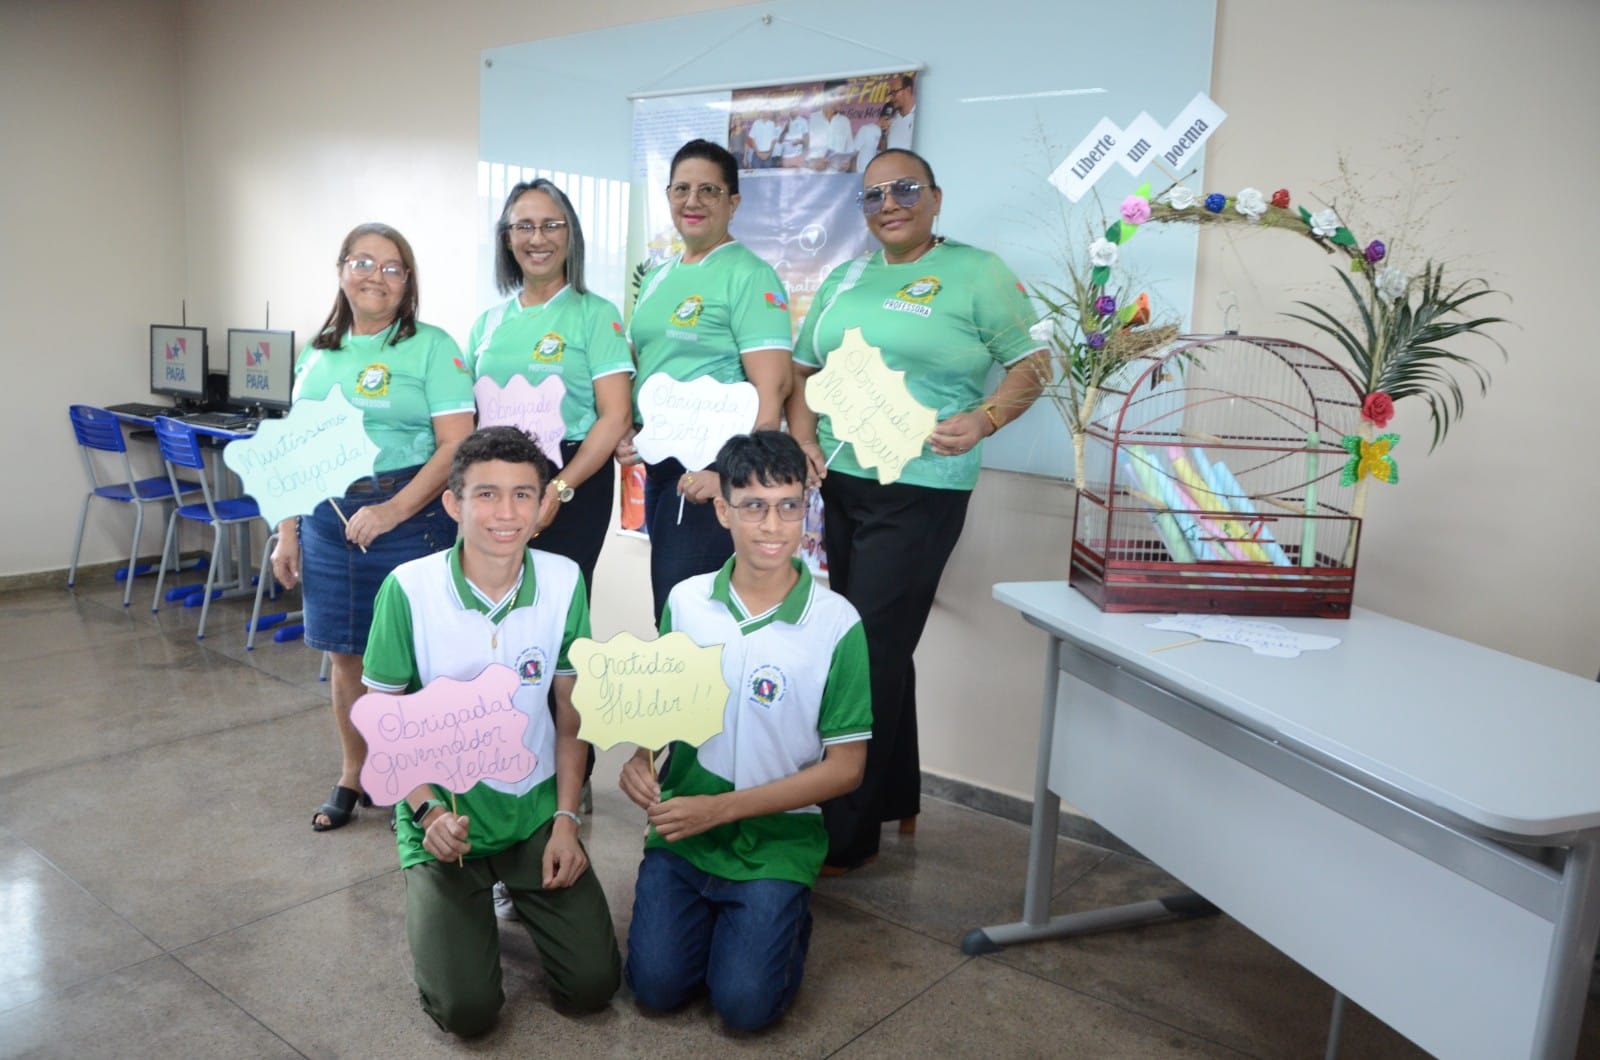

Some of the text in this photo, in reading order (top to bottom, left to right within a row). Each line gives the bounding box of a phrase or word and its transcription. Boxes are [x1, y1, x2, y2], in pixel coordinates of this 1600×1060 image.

[1070, 118, 1209, 180] Liberte um poema
[884, 299, 930, 317] PROFESSORA
